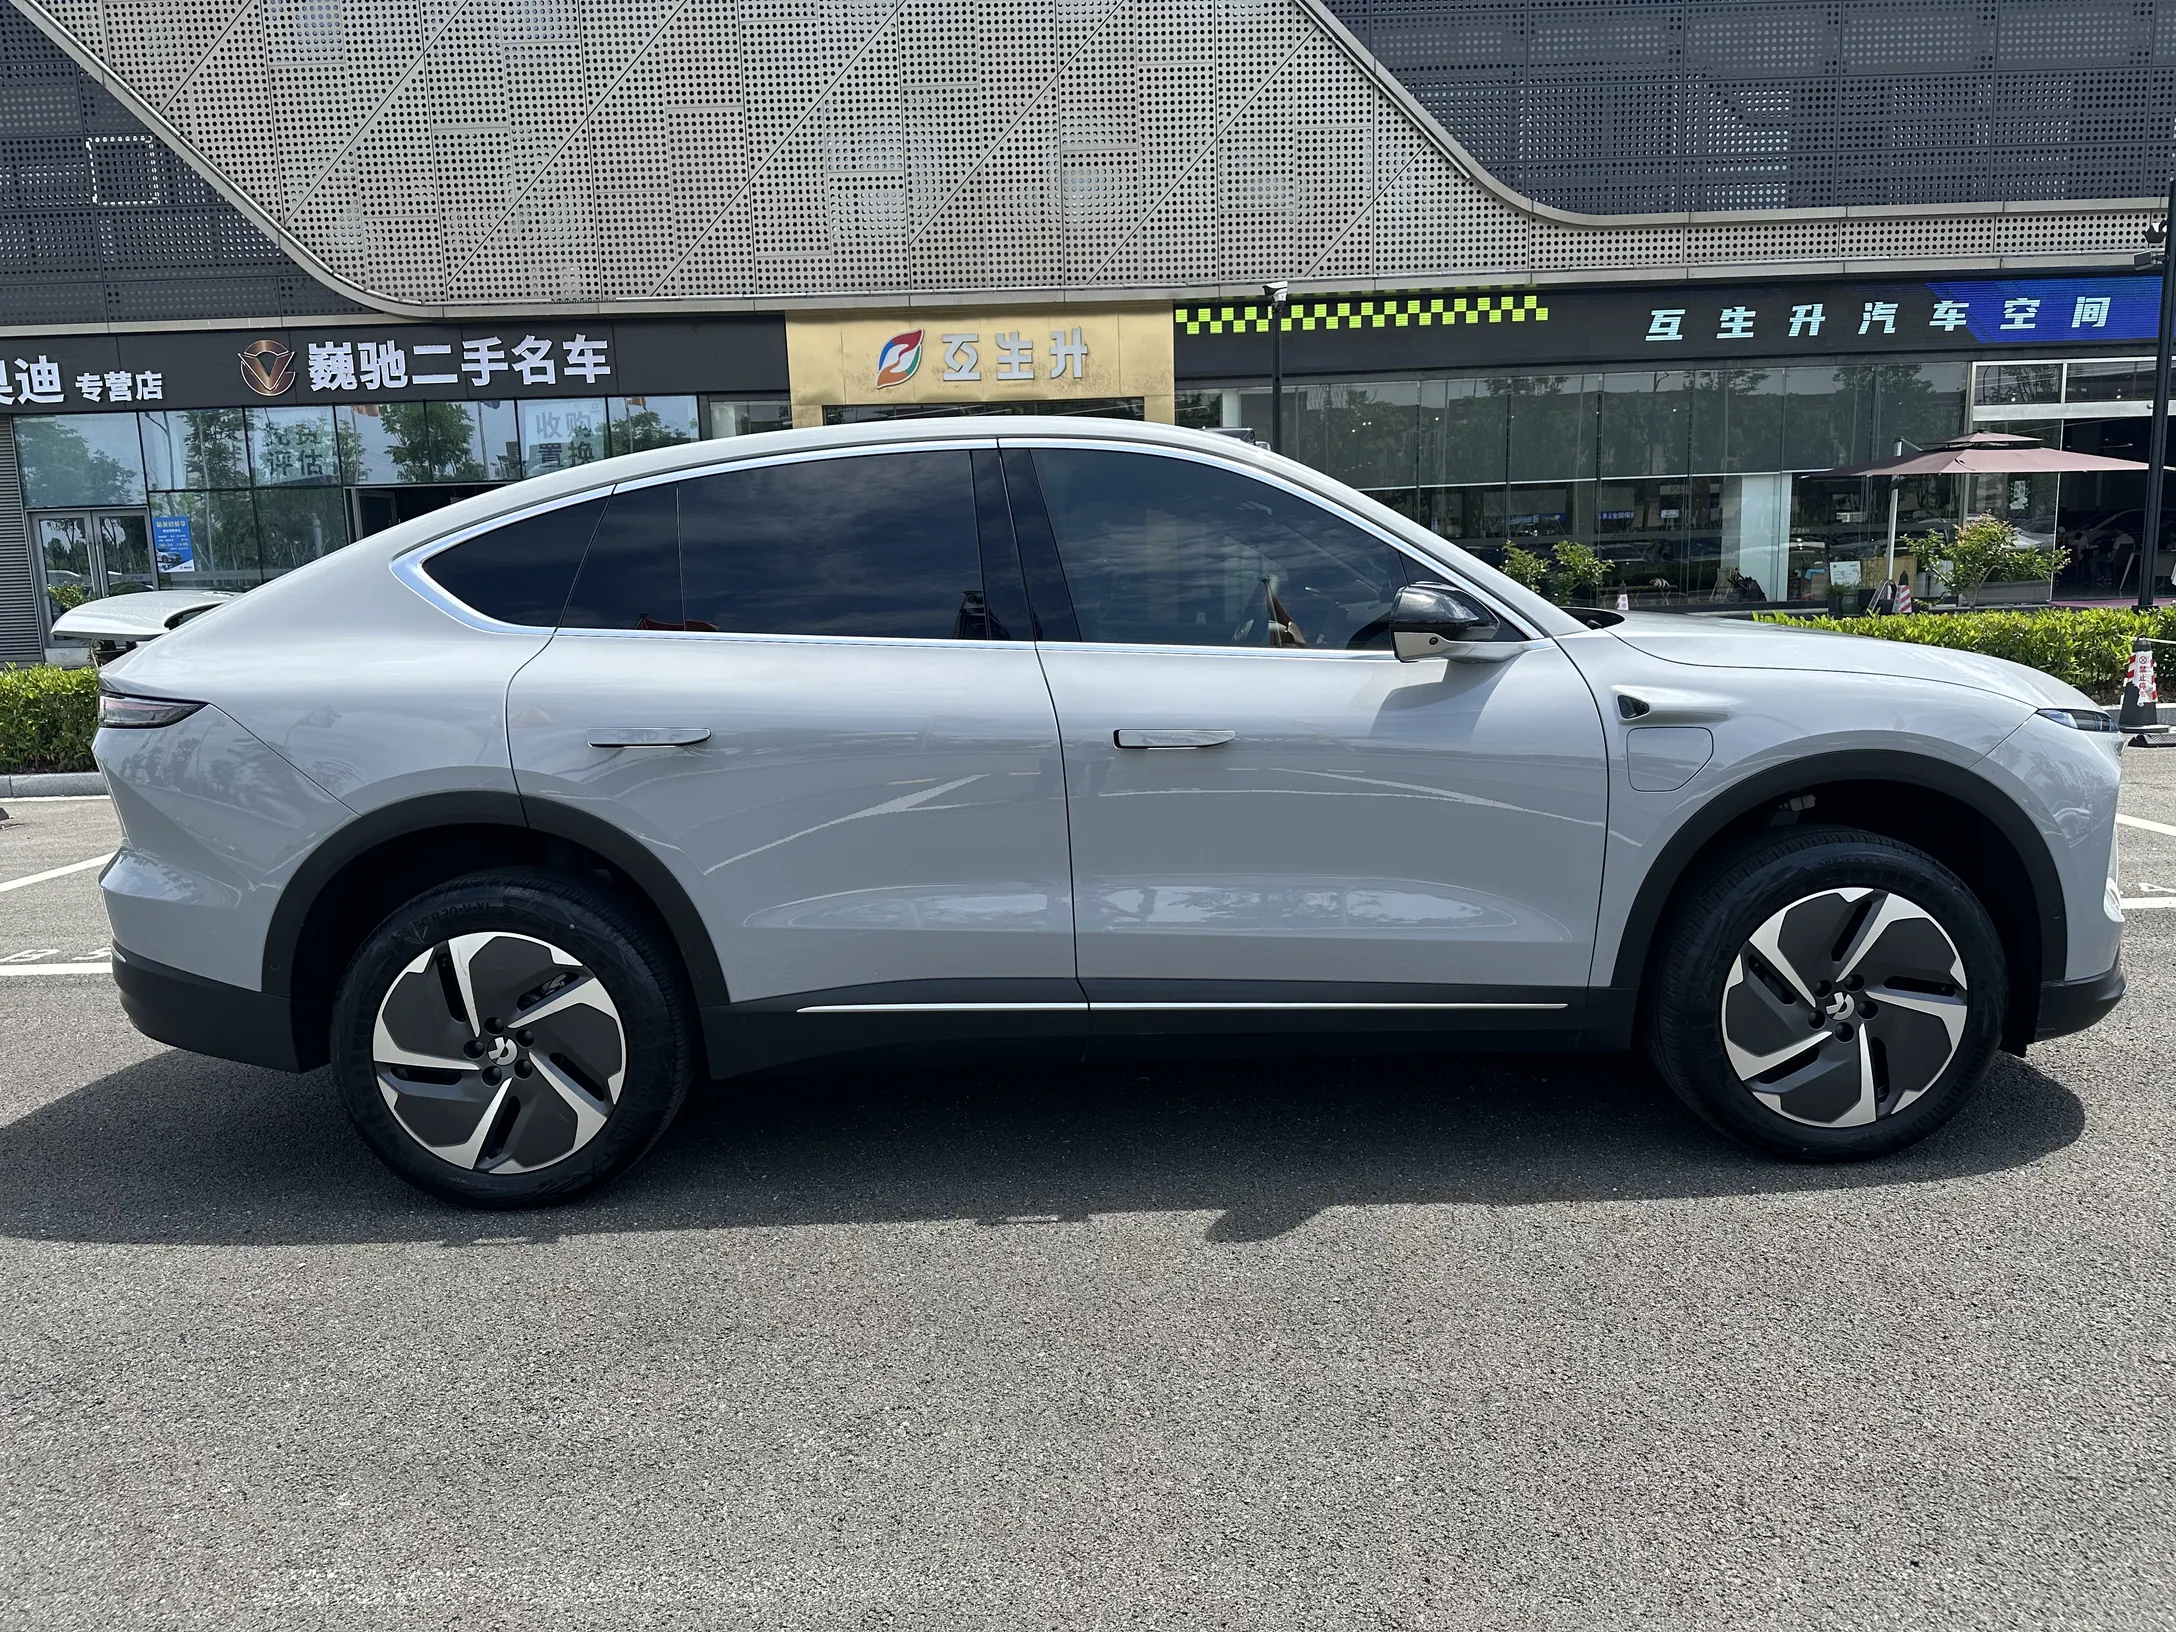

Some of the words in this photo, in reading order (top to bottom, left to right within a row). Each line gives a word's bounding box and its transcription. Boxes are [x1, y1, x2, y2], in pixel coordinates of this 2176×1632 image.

[1645, 297, 2110, 342] 互生升汽车空间
[307, 334, 611, 392] 巍驰二手名车
[942, 328, 1088, 381] 互生升
[75, 370, 163, 402] 专营店
[536, 411, 592, 439] 收购
[267, 449, 323, 476] 评估
[539, 442, 594, 468] 置换
